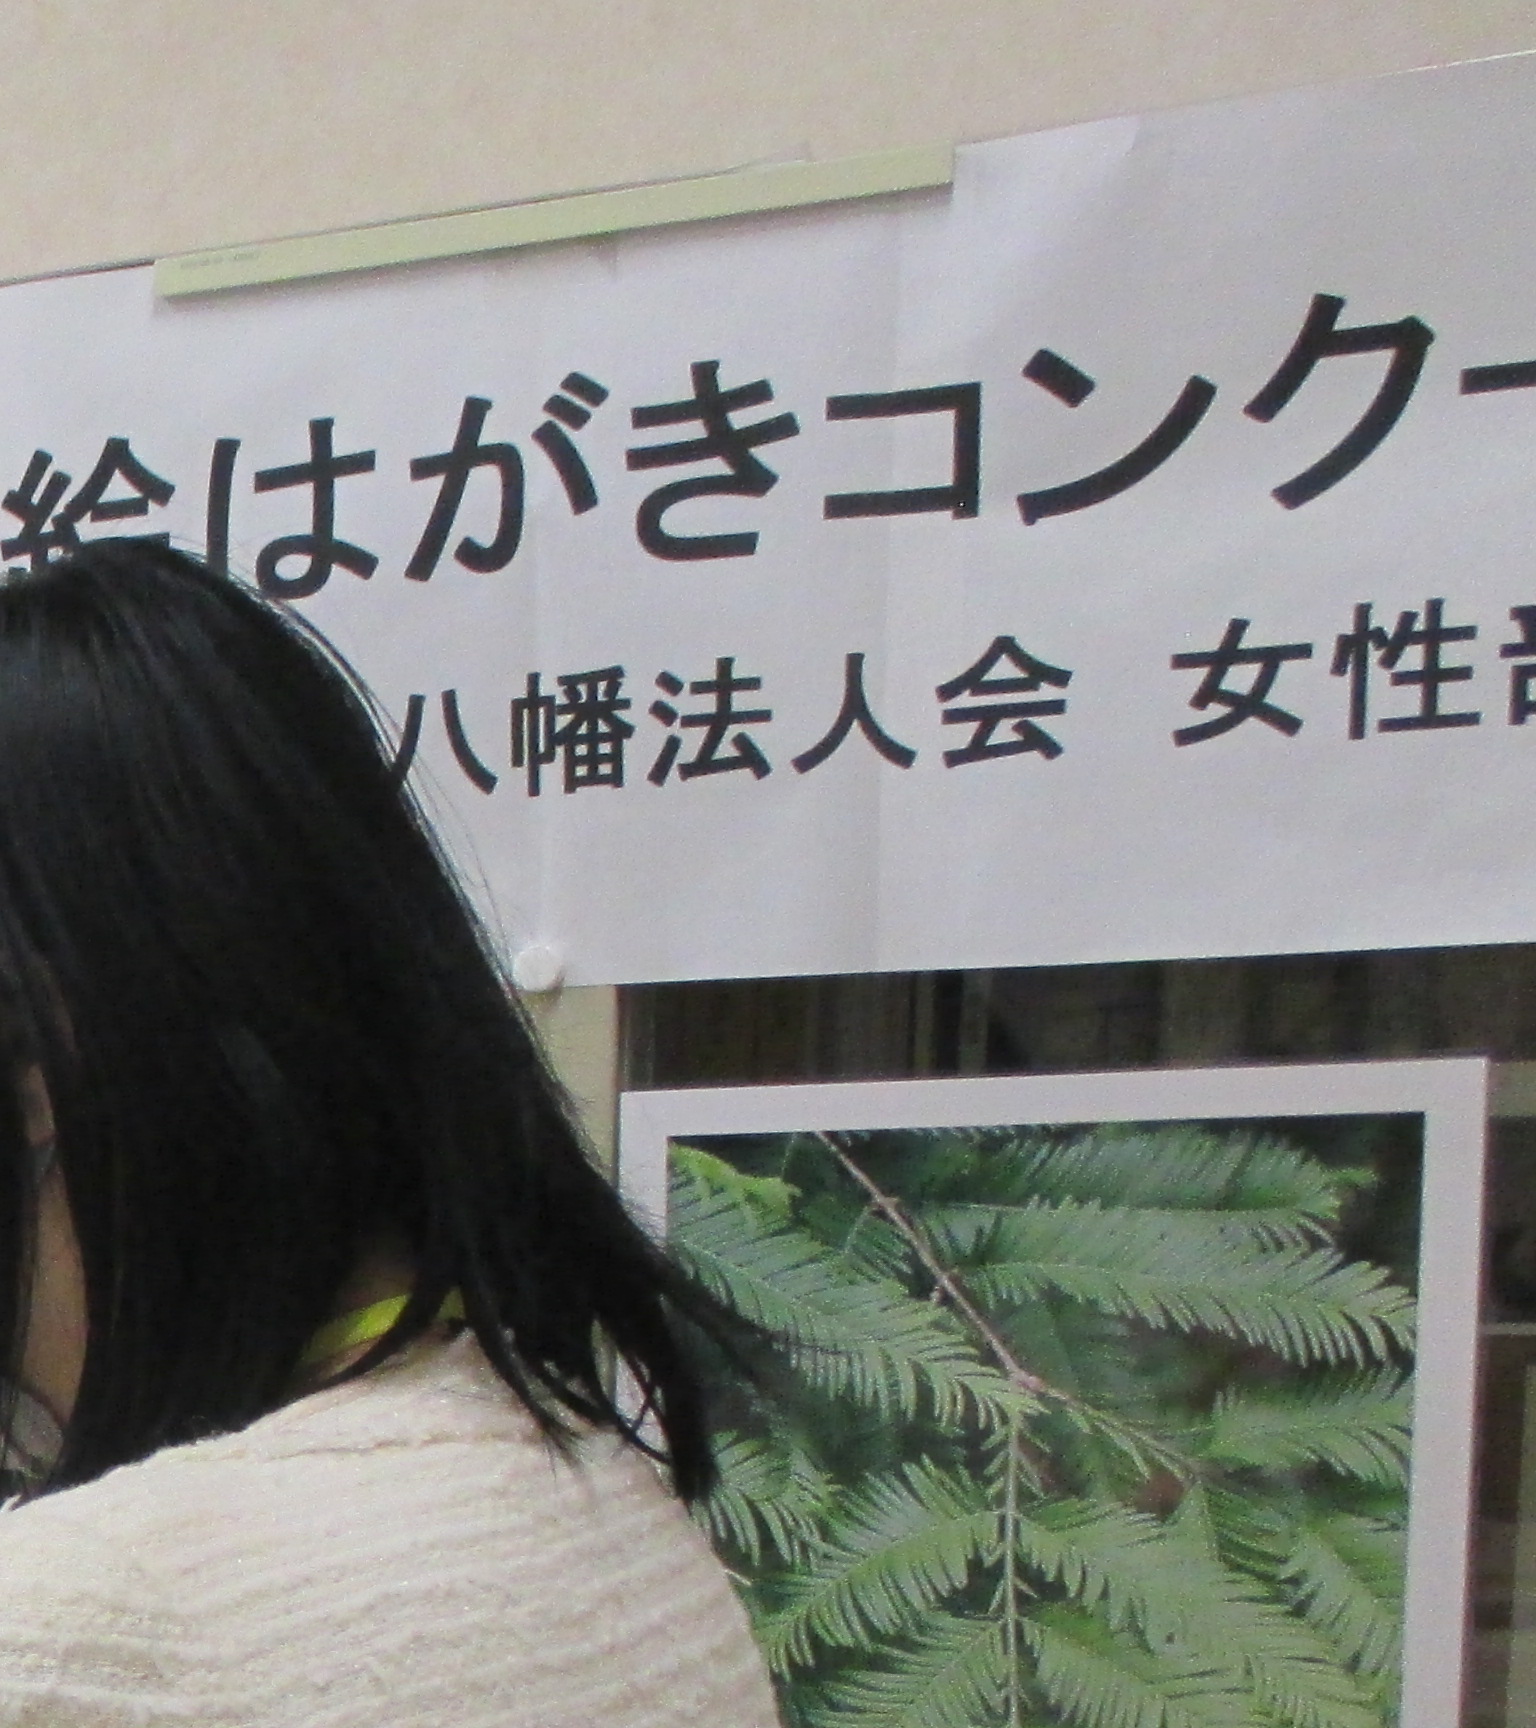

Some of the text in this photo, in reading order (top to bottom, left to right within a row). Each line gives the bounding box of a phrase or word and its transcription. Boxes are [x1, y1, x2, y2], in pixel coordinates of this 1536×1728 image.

[393, 635, 1074, 798] 八幡法人会
